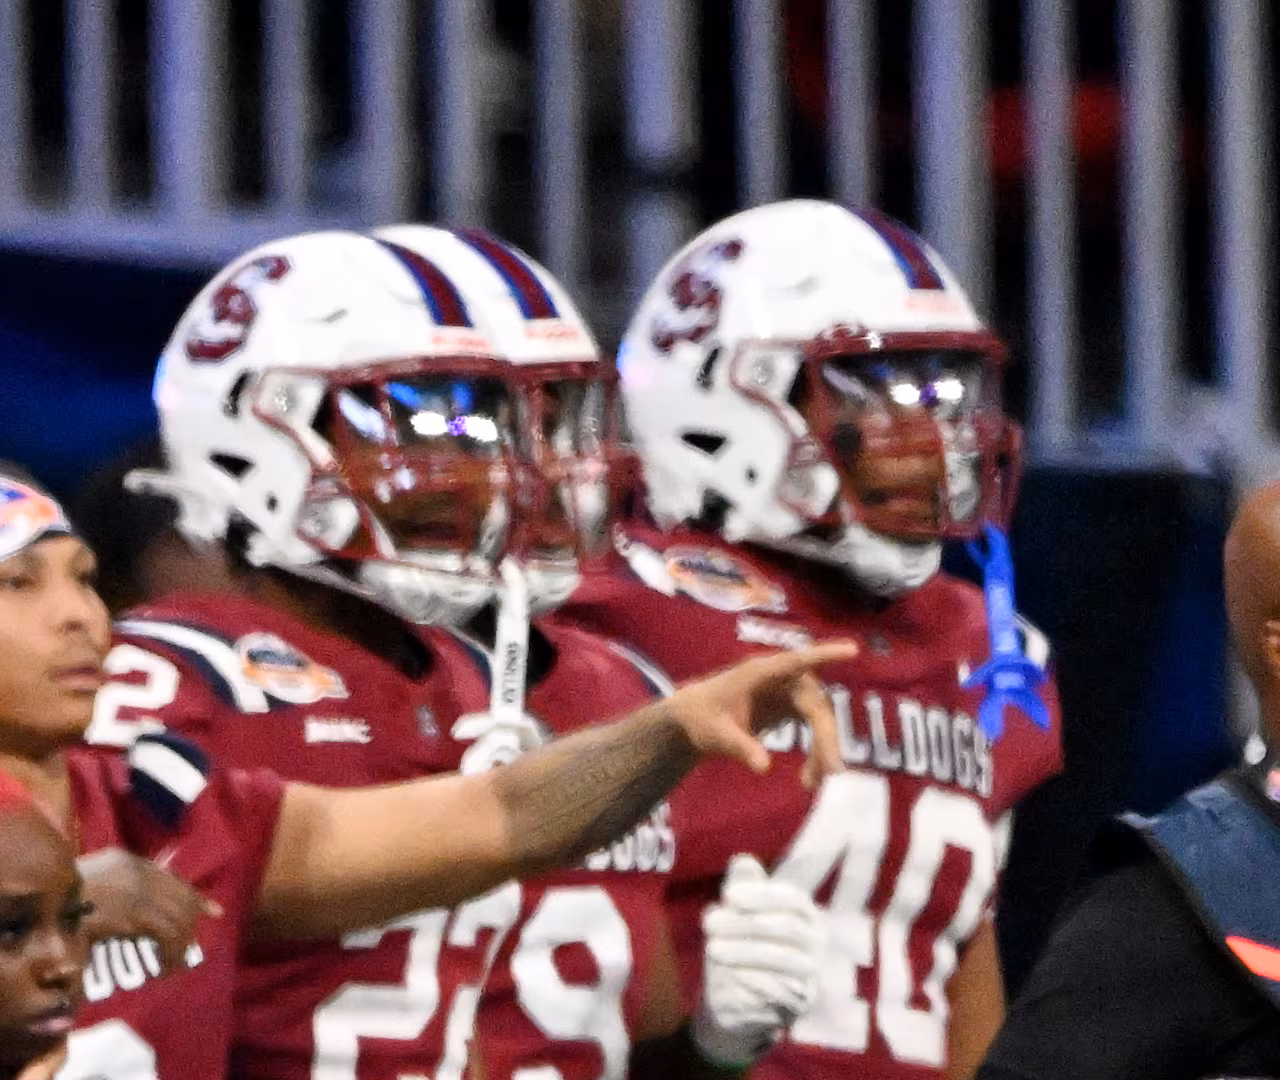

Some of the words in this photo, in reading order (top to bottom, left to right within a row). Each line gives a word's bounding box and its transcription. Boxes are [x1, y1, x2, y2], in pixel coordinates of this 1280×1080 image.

[83, 643, 181, 748] 2
[760, 683, 993, 798] LLDOGS
[766, 770, 992, 1068] 40
